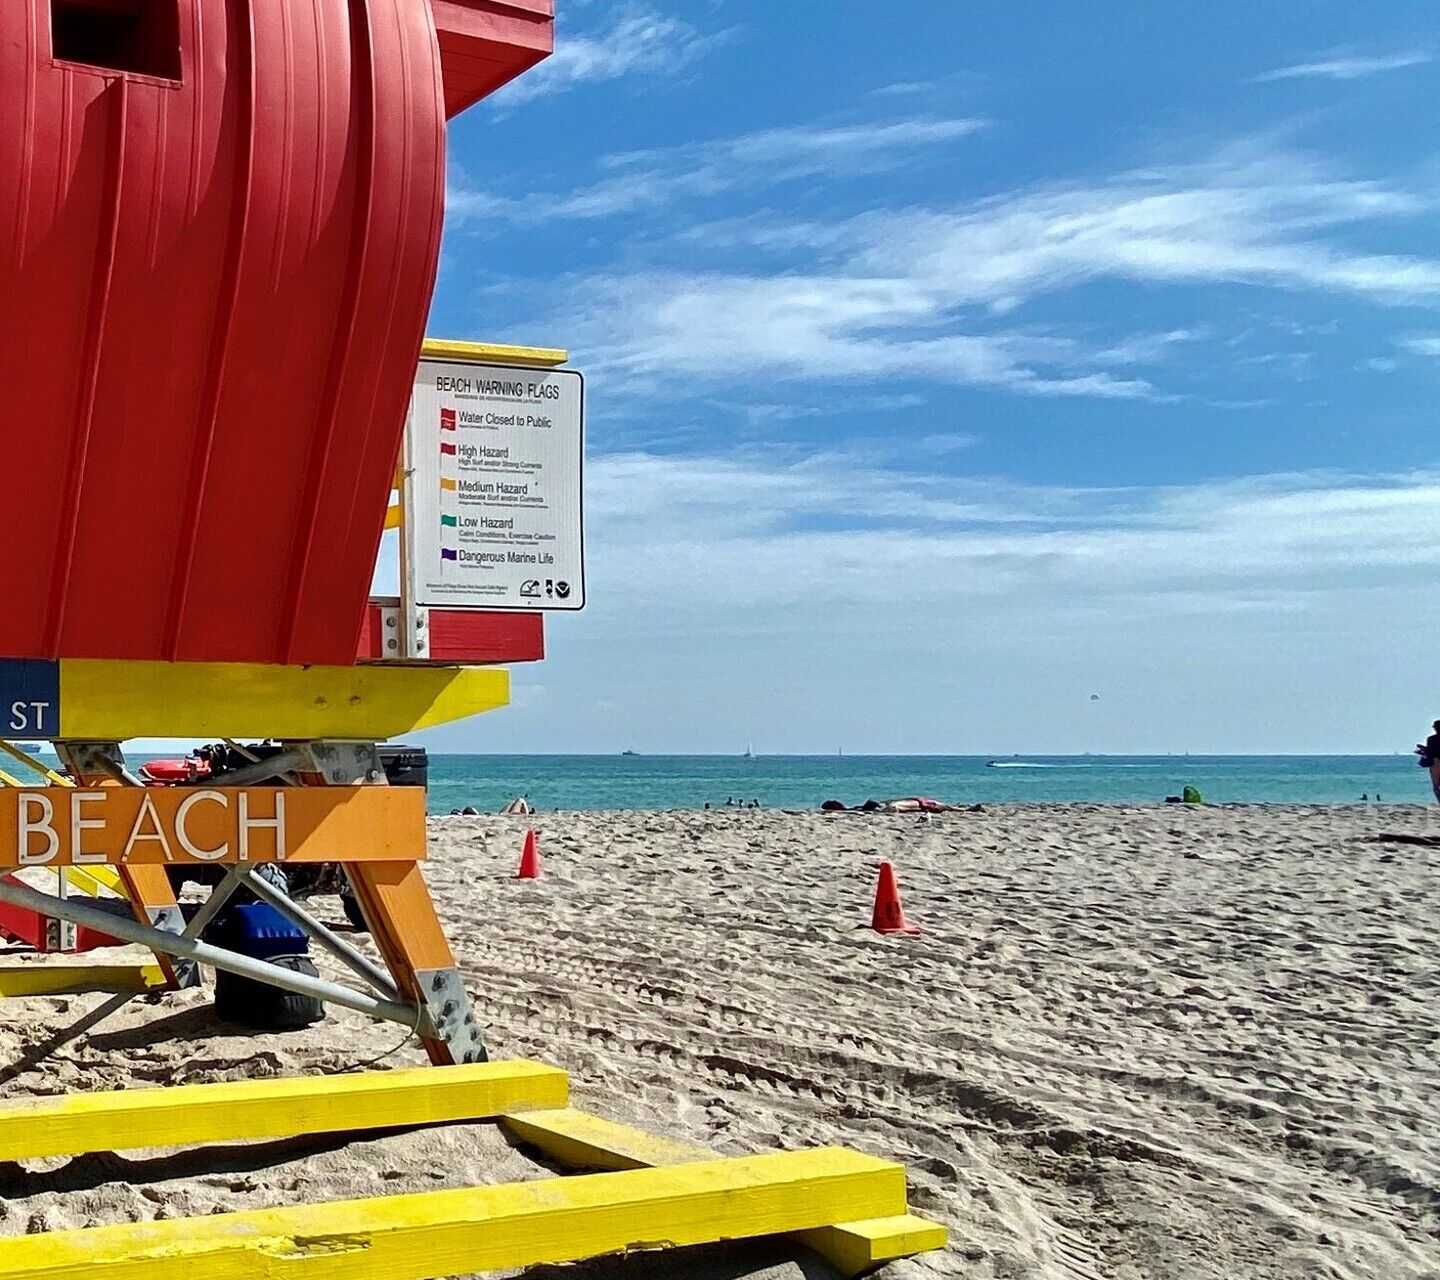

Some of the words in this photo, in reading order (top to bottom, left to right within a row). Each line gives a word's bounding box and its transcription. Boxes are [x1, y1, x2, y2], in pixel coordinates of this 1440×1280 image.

[436, 377, 471, 393] BEACH
[476, 379, 523, 397] WARNING
[528, 383, 560, 400] FLAGS
[459, 411, 484, 423] Water
[485, 412, 515, 426] Closed
[517, 417, 525, 426] to
[526, 415, 552, 428] Public
[458, 444, 478, 459] High
[480, 445, 509, 458] Hazard
[458, 479, 494, 493] Medium
[496, 482, 528, 495] Hazard
[458, 516, 478, 527] Low
[480, 516, 514, 529] Hazard
[459, 549, 505, 564] Dangerous
[507, 551, 536, 563] Marine
[538, 553, 554, 564] Life
[9, 701, 50, 731] ST
[18, 790, 287, 865] BEACH
